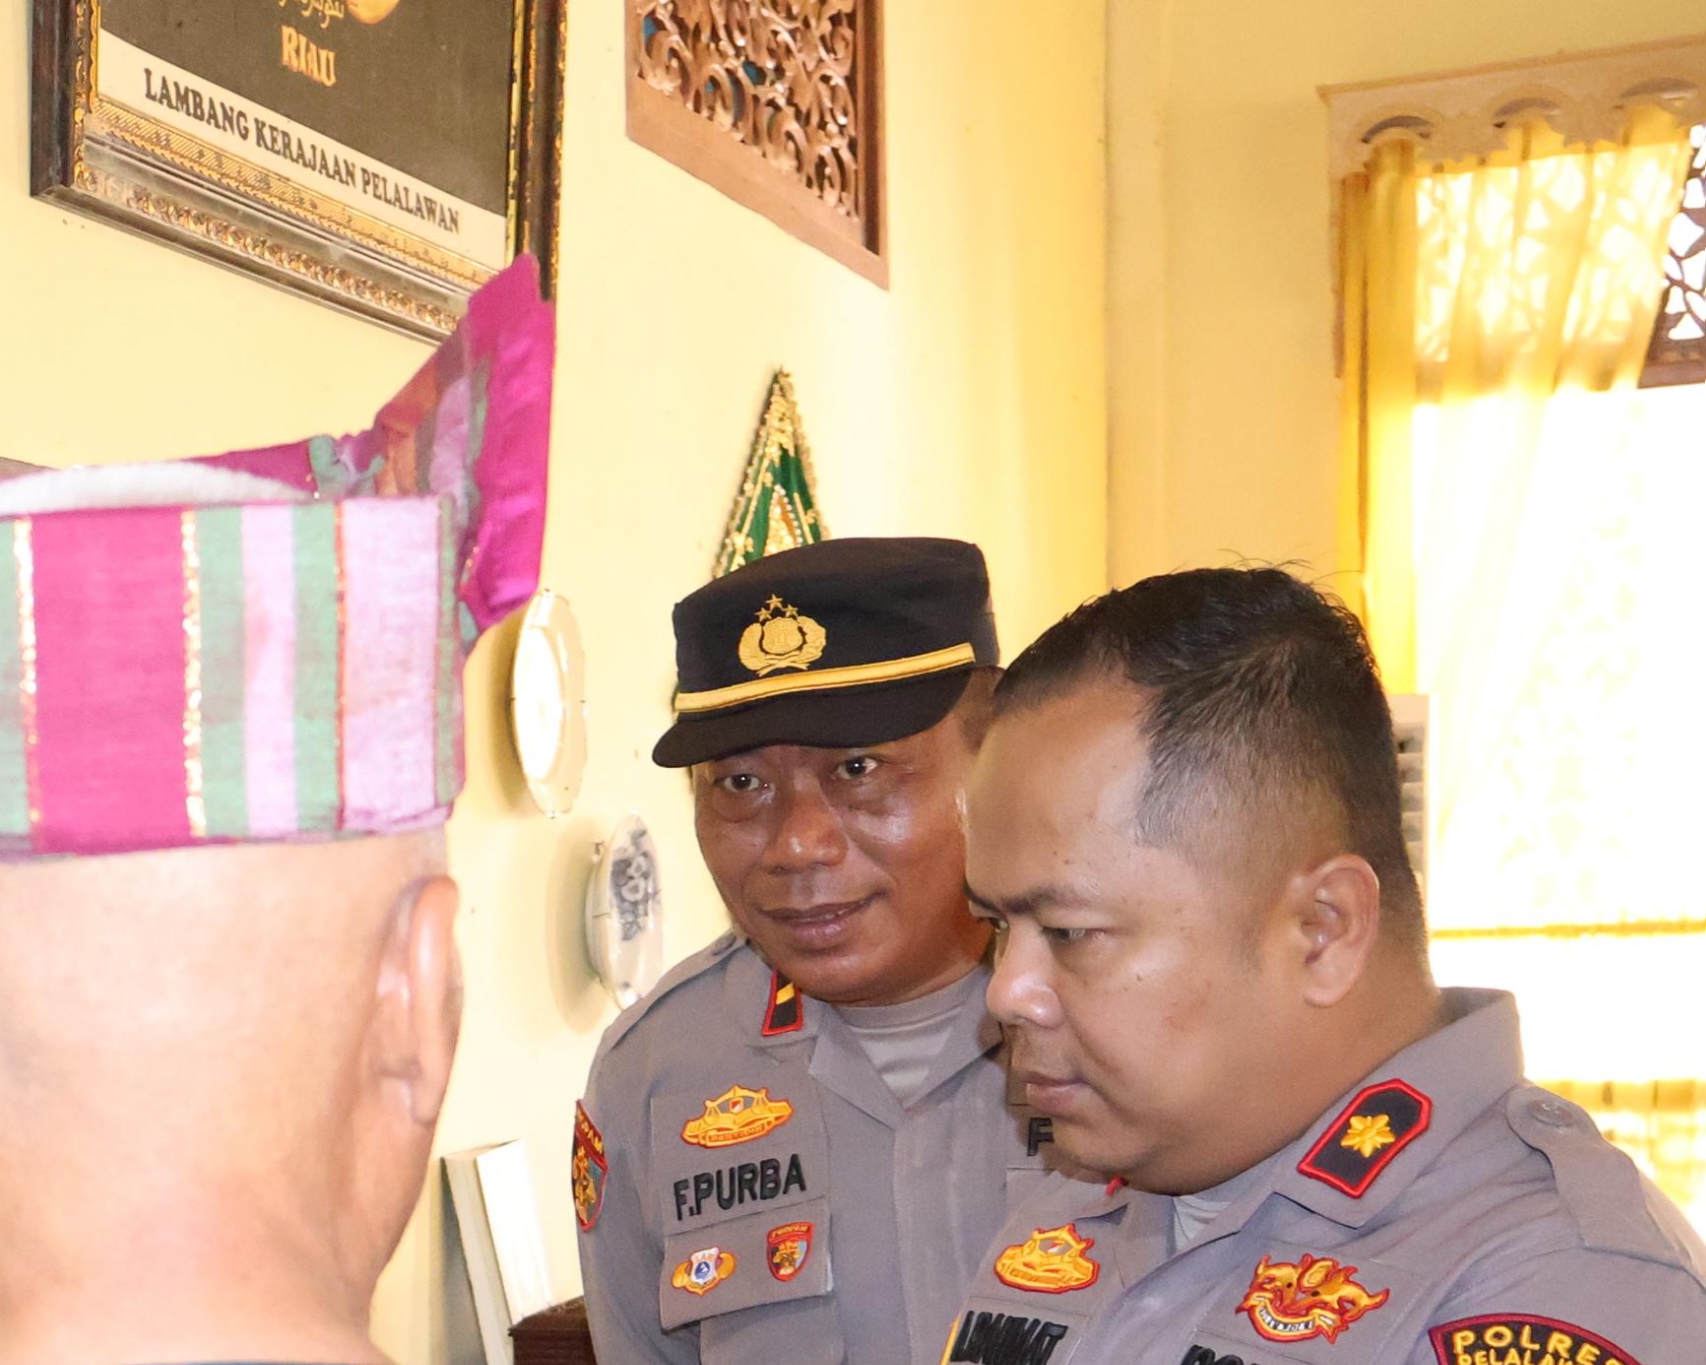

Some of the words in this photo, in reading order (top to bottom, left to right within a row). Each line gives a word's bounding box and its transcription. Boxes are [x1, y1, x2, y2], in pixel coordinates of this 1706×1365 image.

[280, 25, 337, 87] RIAU
[143, 67, 250, 141] LAMBANG
[254, 117, 357, 187] KERAJAAN
[360, 167, 461, 234] PELALAWAN
[673, 1153, 807, 1221] F.PURBA
